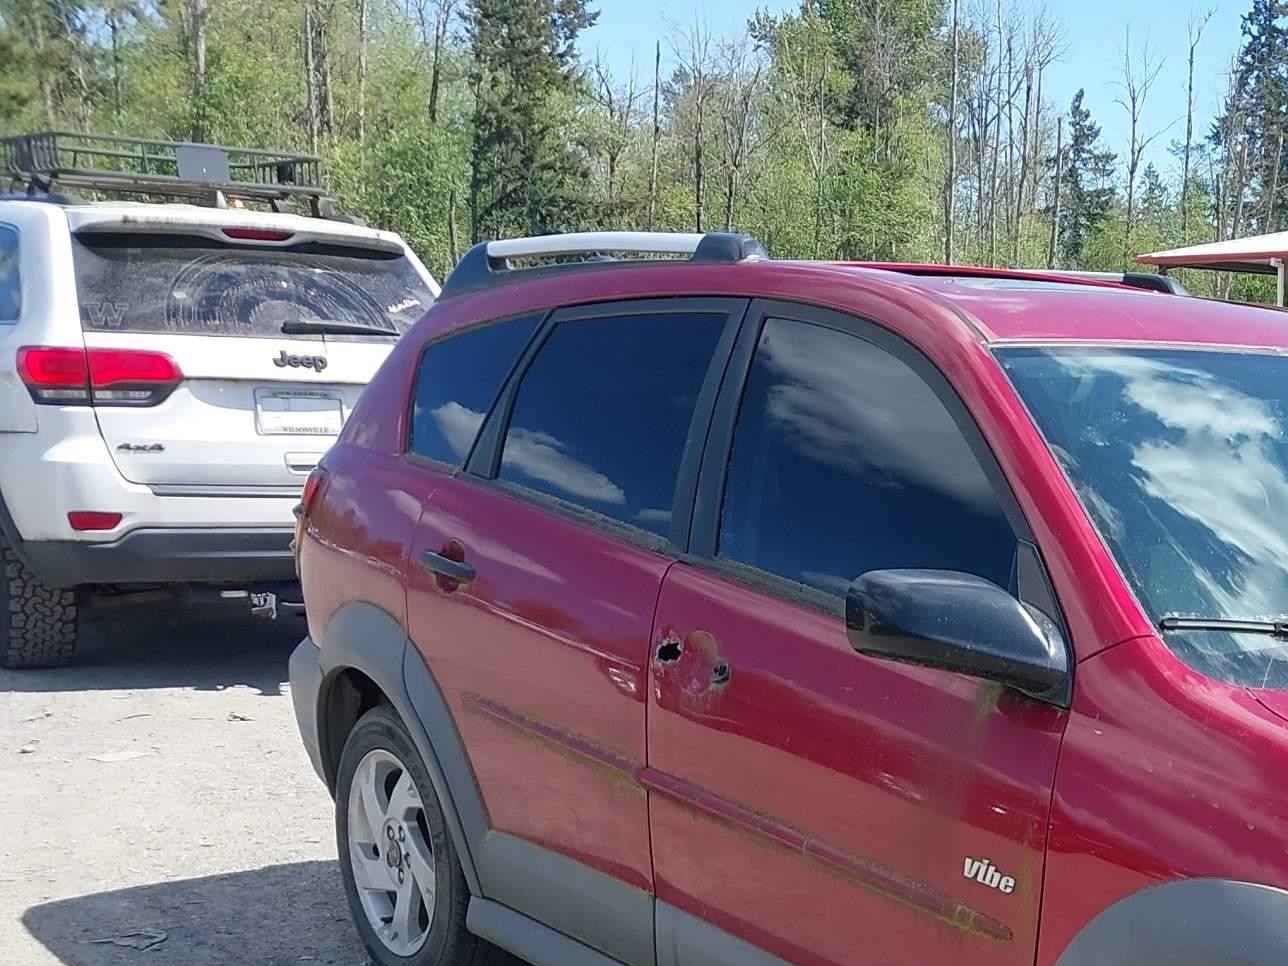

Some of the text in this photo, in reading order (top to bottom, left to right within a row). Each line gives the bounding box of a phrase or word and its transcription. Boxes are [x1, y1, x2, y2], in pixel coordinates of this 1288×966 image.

[82, 302, 129, 327] W
[272, 350, 328, 373] Jeep
[962, 855, 1017, 895] vibe
